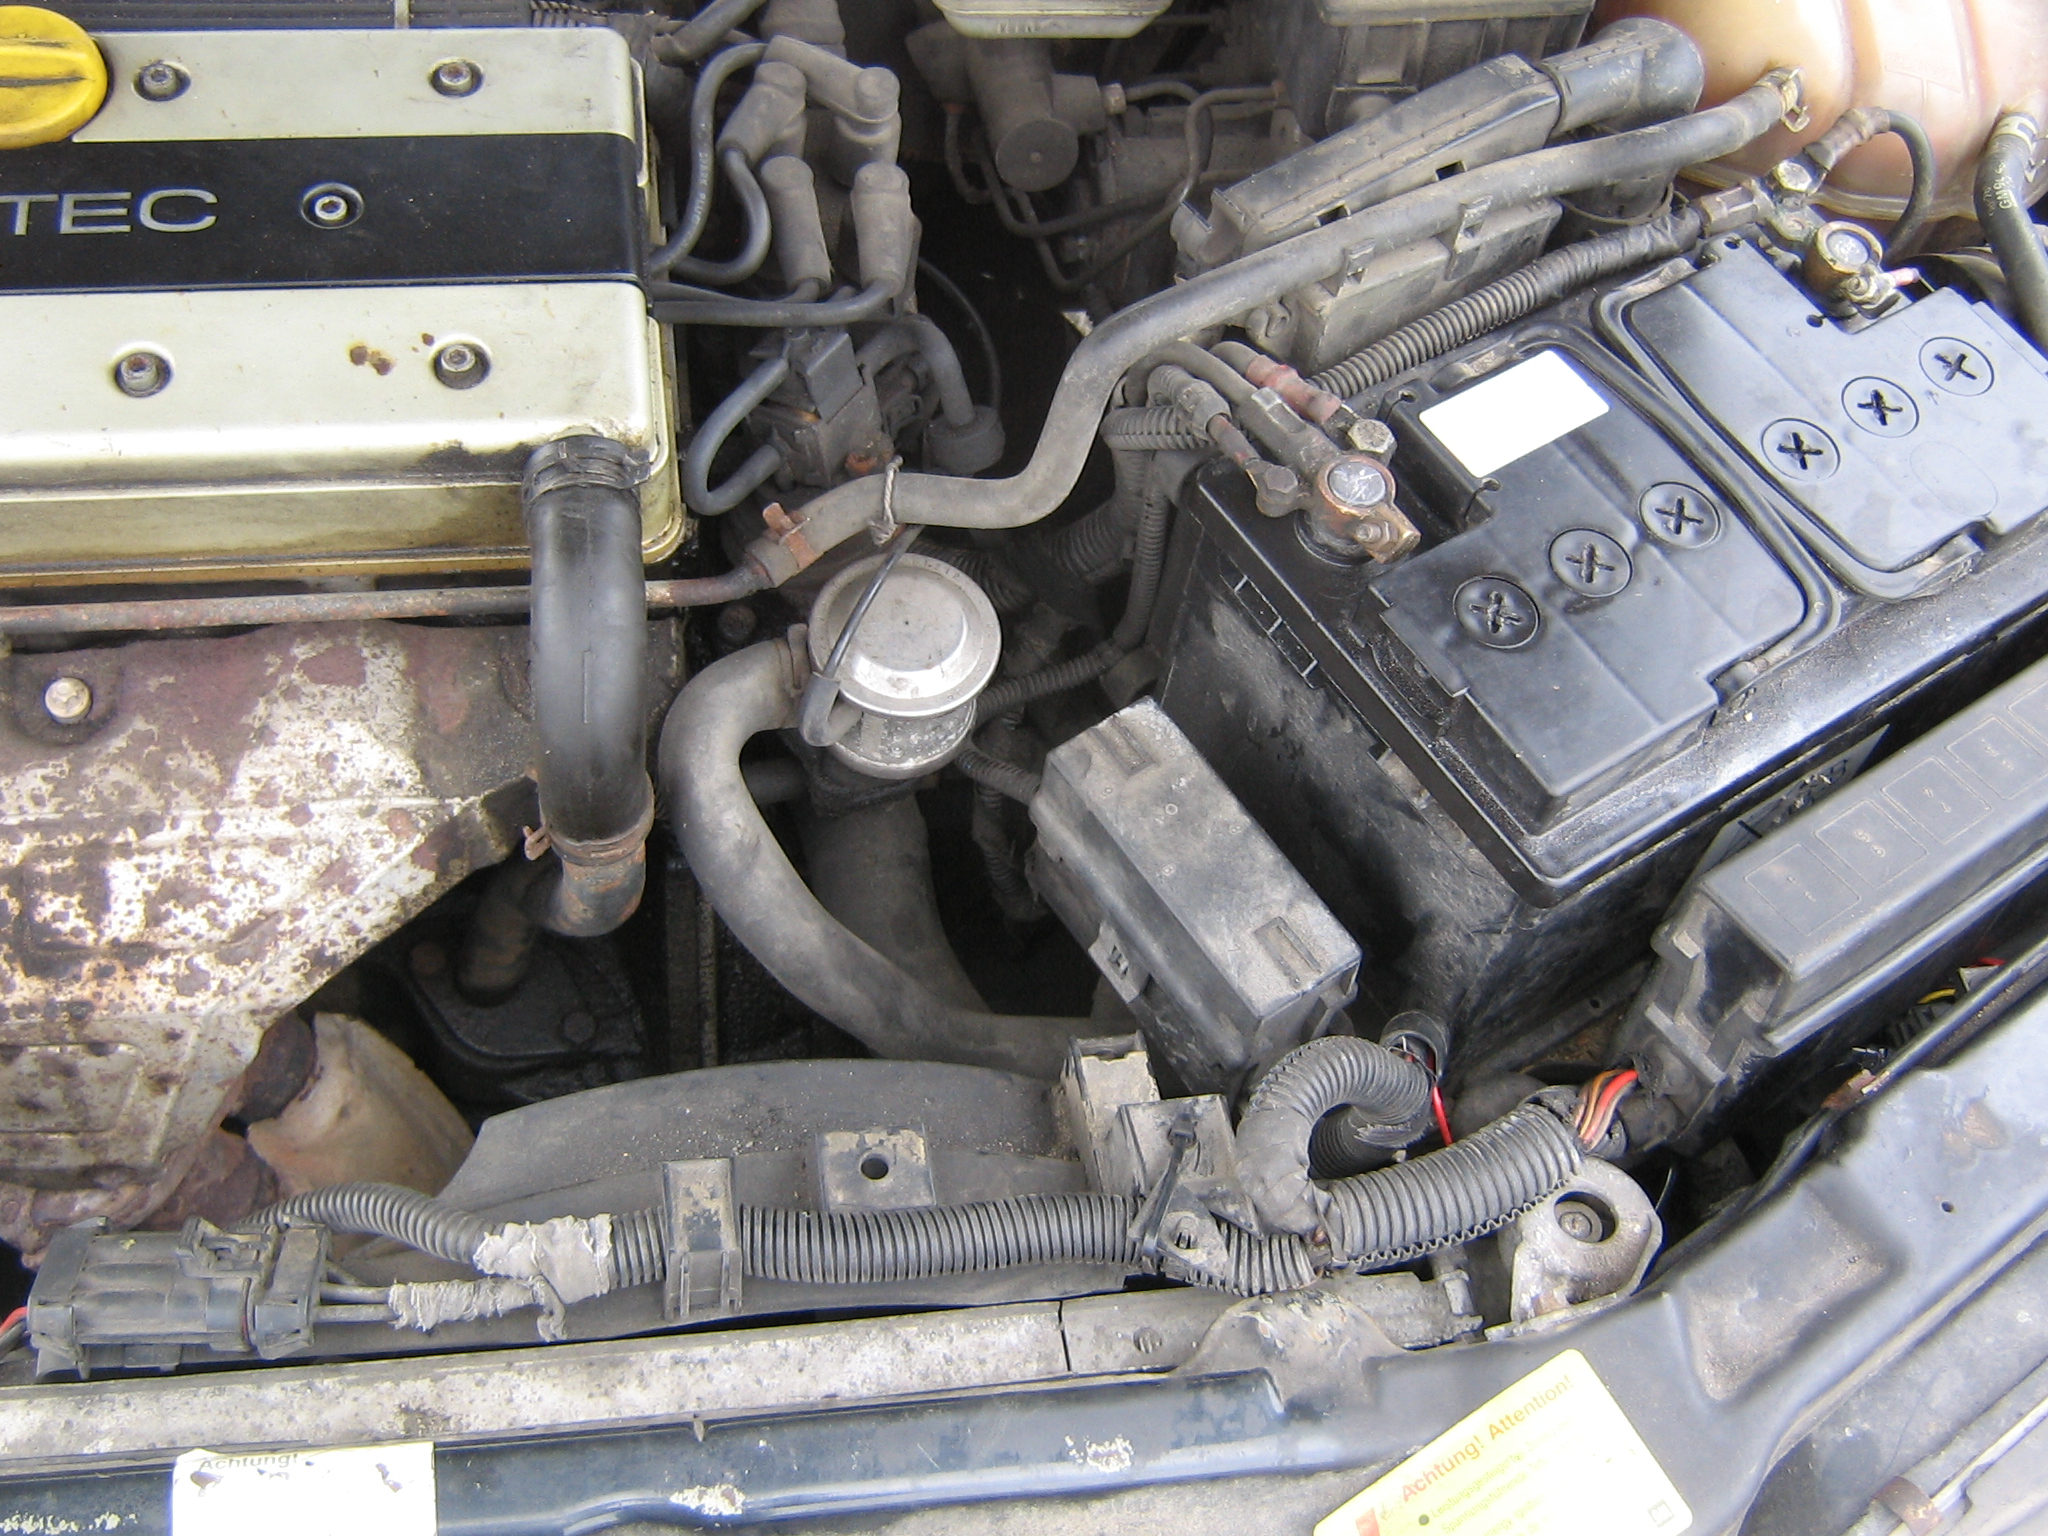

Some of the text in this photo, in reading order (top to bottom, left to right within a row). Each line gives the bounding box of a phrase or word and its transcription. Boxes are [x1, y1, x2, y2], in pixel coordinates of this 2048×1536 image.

[0, 188, 218, 236] TEC
[199, 1452, 299, 1471] Achtung!
[1402, 1433, 1486, 1502] Achtung!
[1488, 1374, 1574, 1440] Attention!
